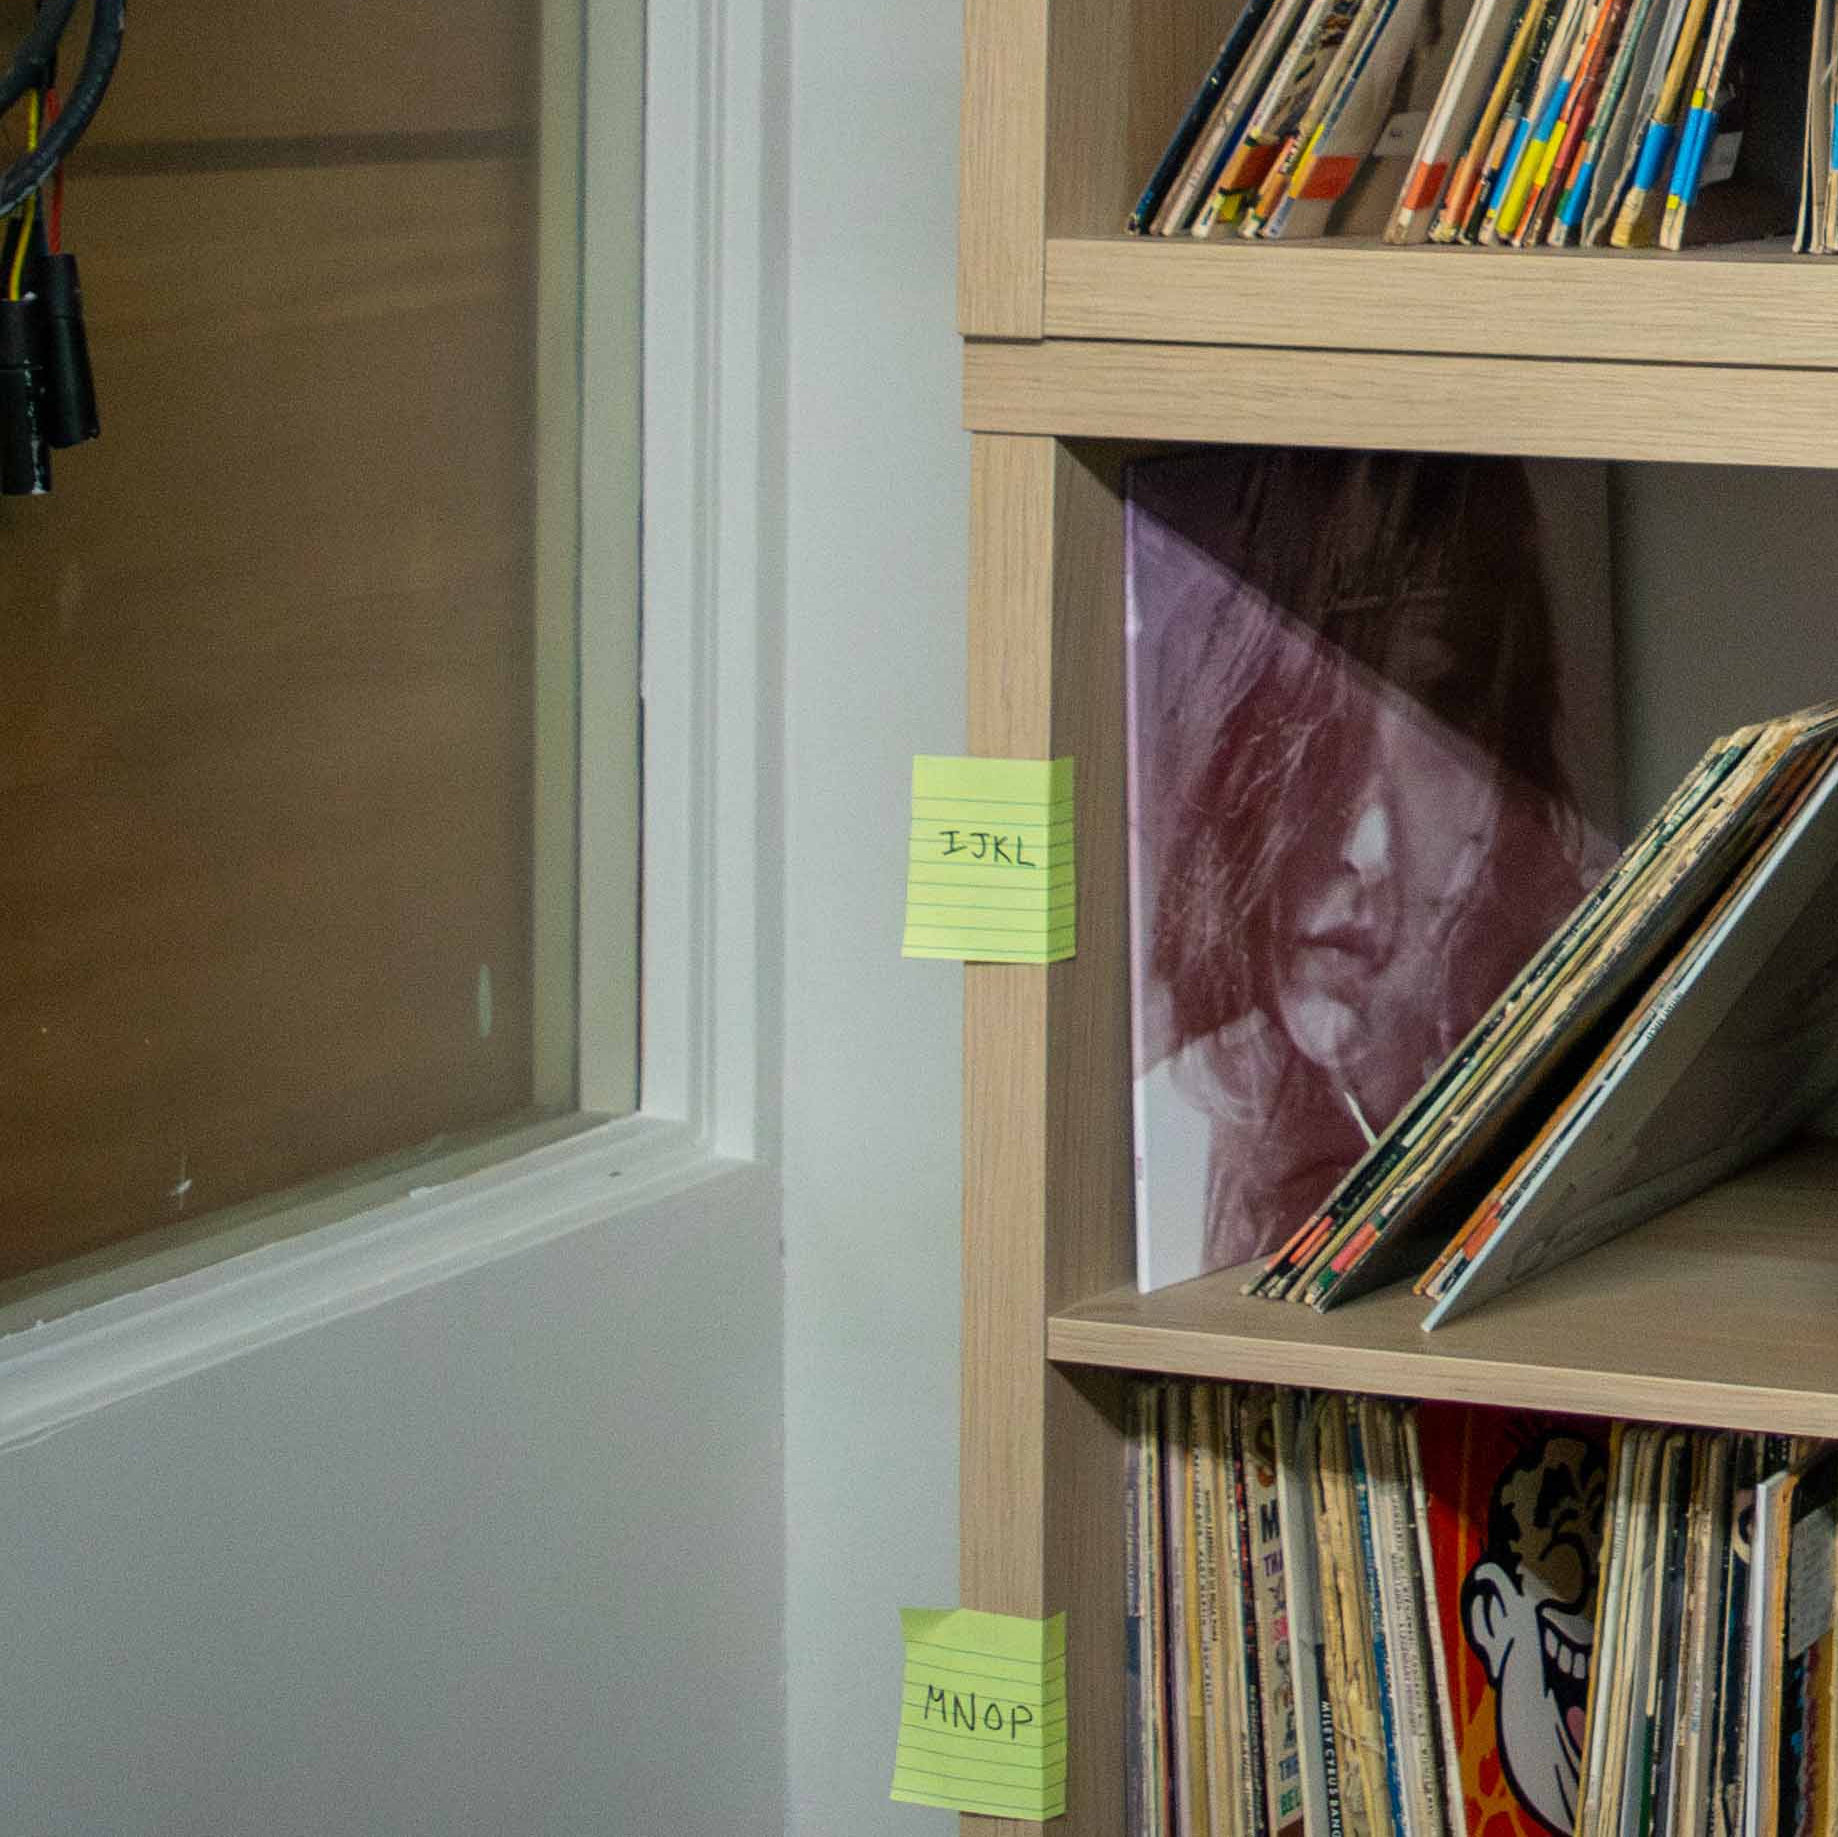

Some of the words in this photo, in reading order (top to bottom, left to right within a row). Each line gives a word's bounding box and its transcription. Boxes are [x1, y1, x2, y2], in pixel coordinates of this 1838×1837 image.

[939, 829, 1037, 868] IJKL
[923, 1683, 1034, 1741] MNOP
[1317, 1699, 1334, 1747] MILEY
[1322, 1747, 1339, 1795] CYRUS
